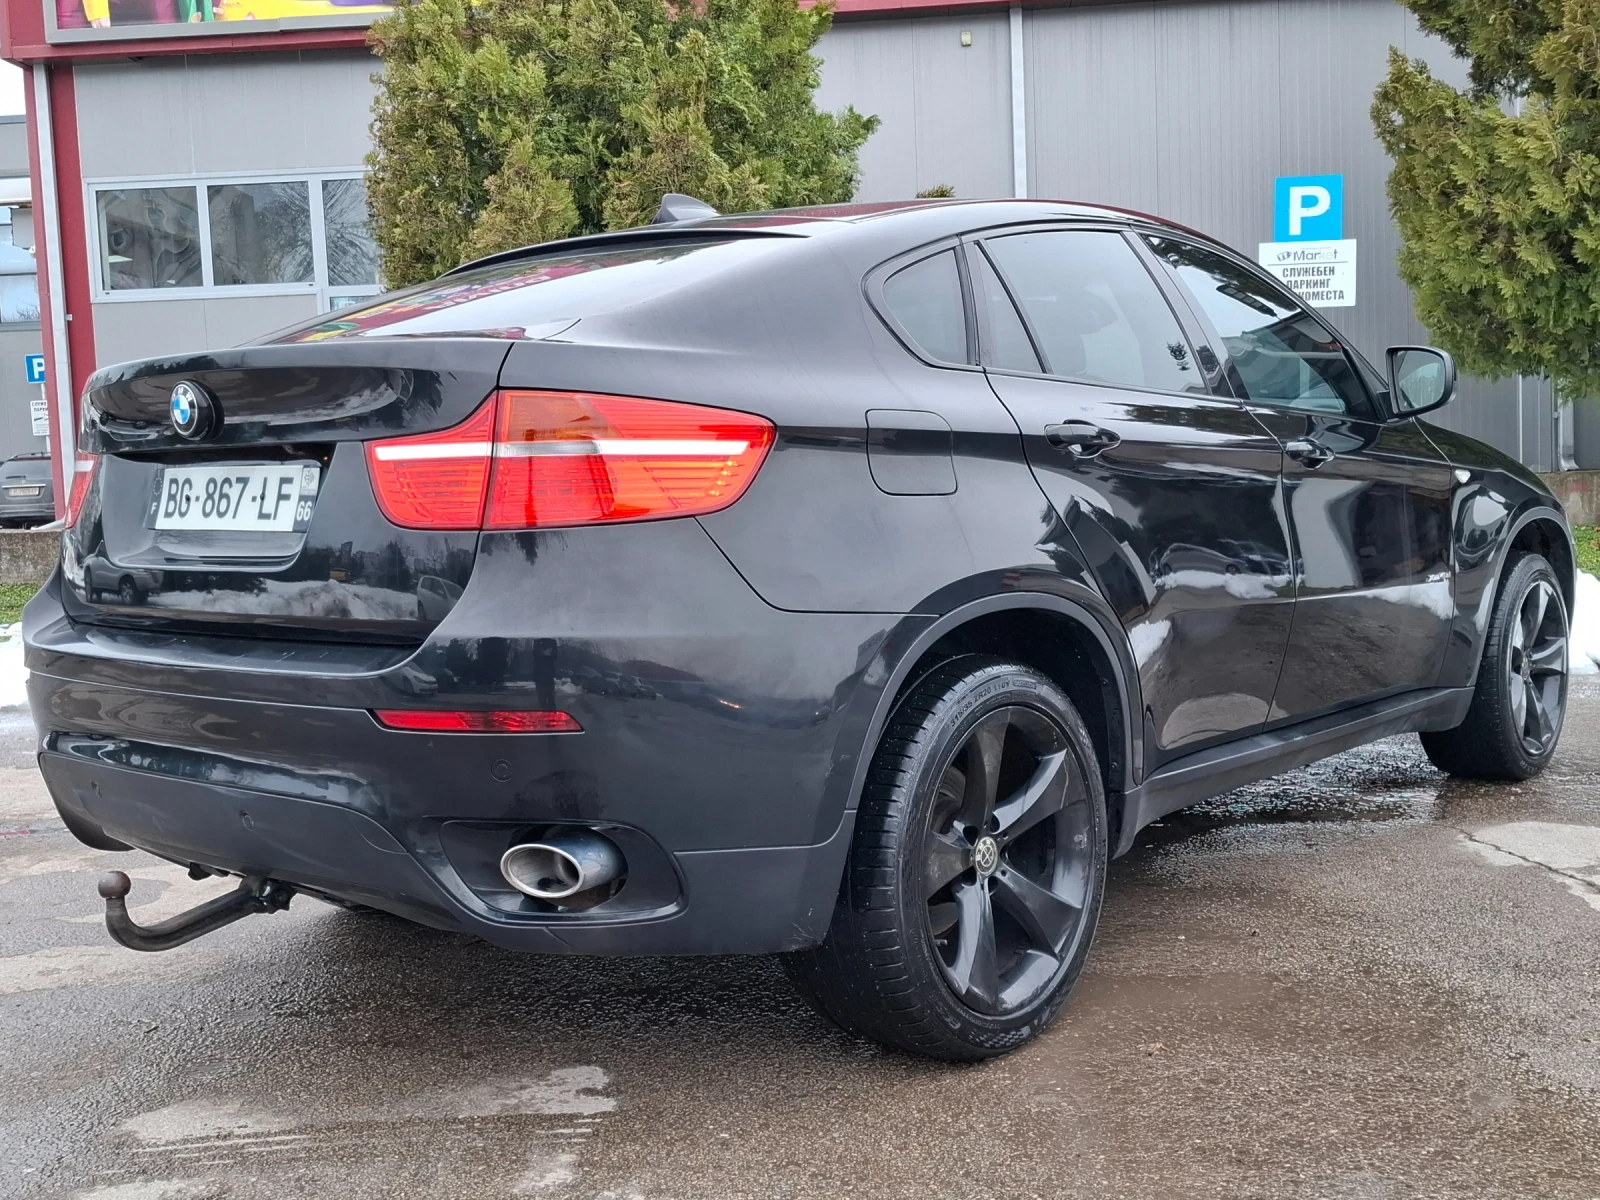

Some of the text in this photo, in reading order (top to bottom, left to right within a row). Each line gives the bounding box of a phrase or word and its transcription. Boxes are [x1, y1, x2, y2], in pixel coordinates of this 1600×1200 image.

[1289, 186, 1331, 236] P
[1293, 248, 1338, 261] Market
[1282, 266, 1335, 278] СЛУЖЕБЕН
[1286, 278, 1331, 290] ПАРКИНГ
[1296, 290, 1345, 301] КОМЕСТА
[32, 357, 45, 379] P
[150, 502, 157, 515] F
[163, 476, 294, 520] BG-867-LF
[296, 501, 312, 521] 66
